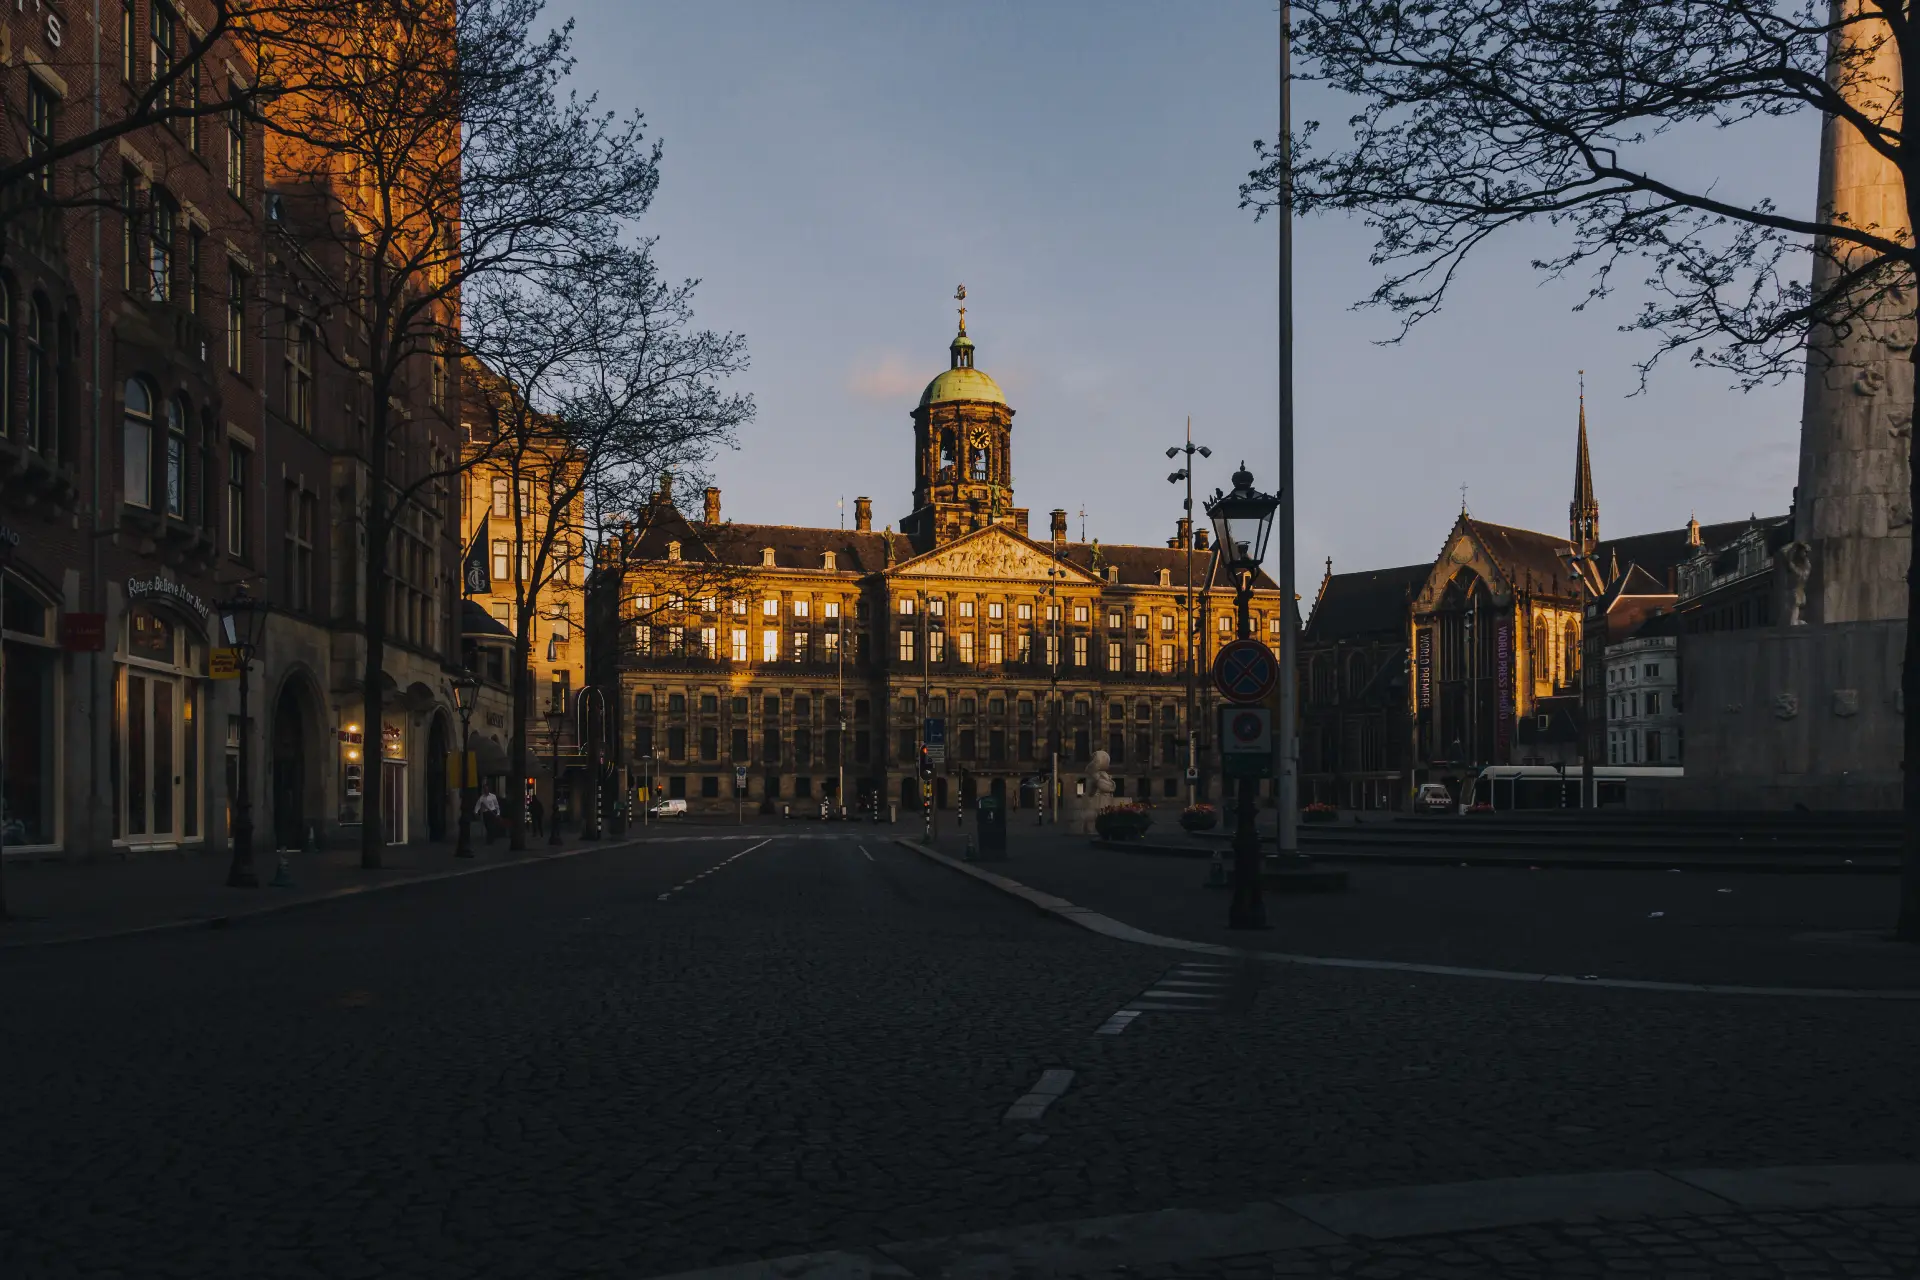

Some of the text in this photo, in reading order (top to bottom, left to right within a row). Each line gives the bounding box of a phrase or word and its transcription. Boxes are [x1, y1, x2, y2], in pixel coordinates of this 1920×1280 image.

[154, 576, 179, 595] Believe
[179, 583, 186, 600] It
[186, 591, 194, 605] or
[193, 595, 209, 619] Not!
[1498, 626, 1508, 659] WORLD
[1419, 633, 1430, 709] WORLD PREMIERE
[1498, 660, 1508, 687] PRESS
[1499, 689, 1509, 720] PHOTO
